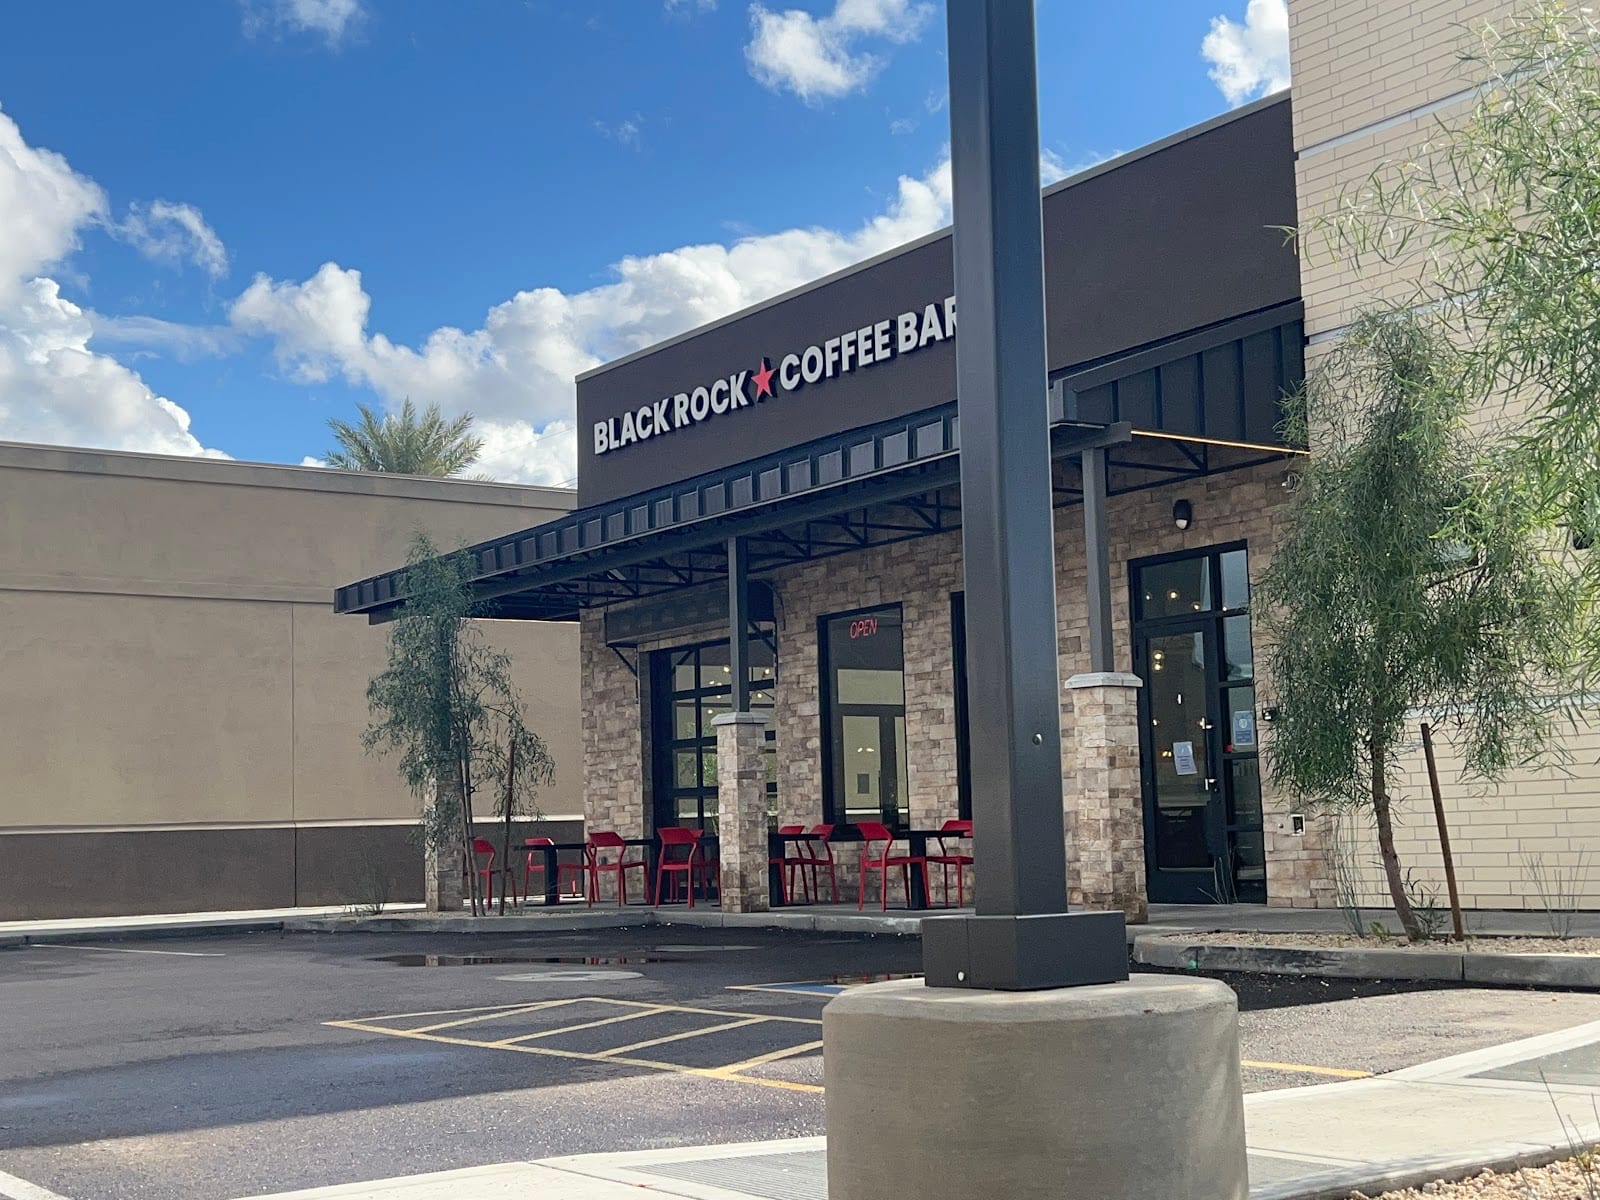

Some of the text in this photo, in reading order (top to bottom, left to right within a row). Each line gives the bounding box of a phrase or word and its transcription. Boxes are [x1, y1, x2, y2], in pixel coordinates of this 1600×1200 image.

[594, 398, 669, 455] BLACK
[674, 371, 748, 428] ROCK
[779, 320, 891, 391] COFFEE
[849, 618, 878, 639] OPEN
